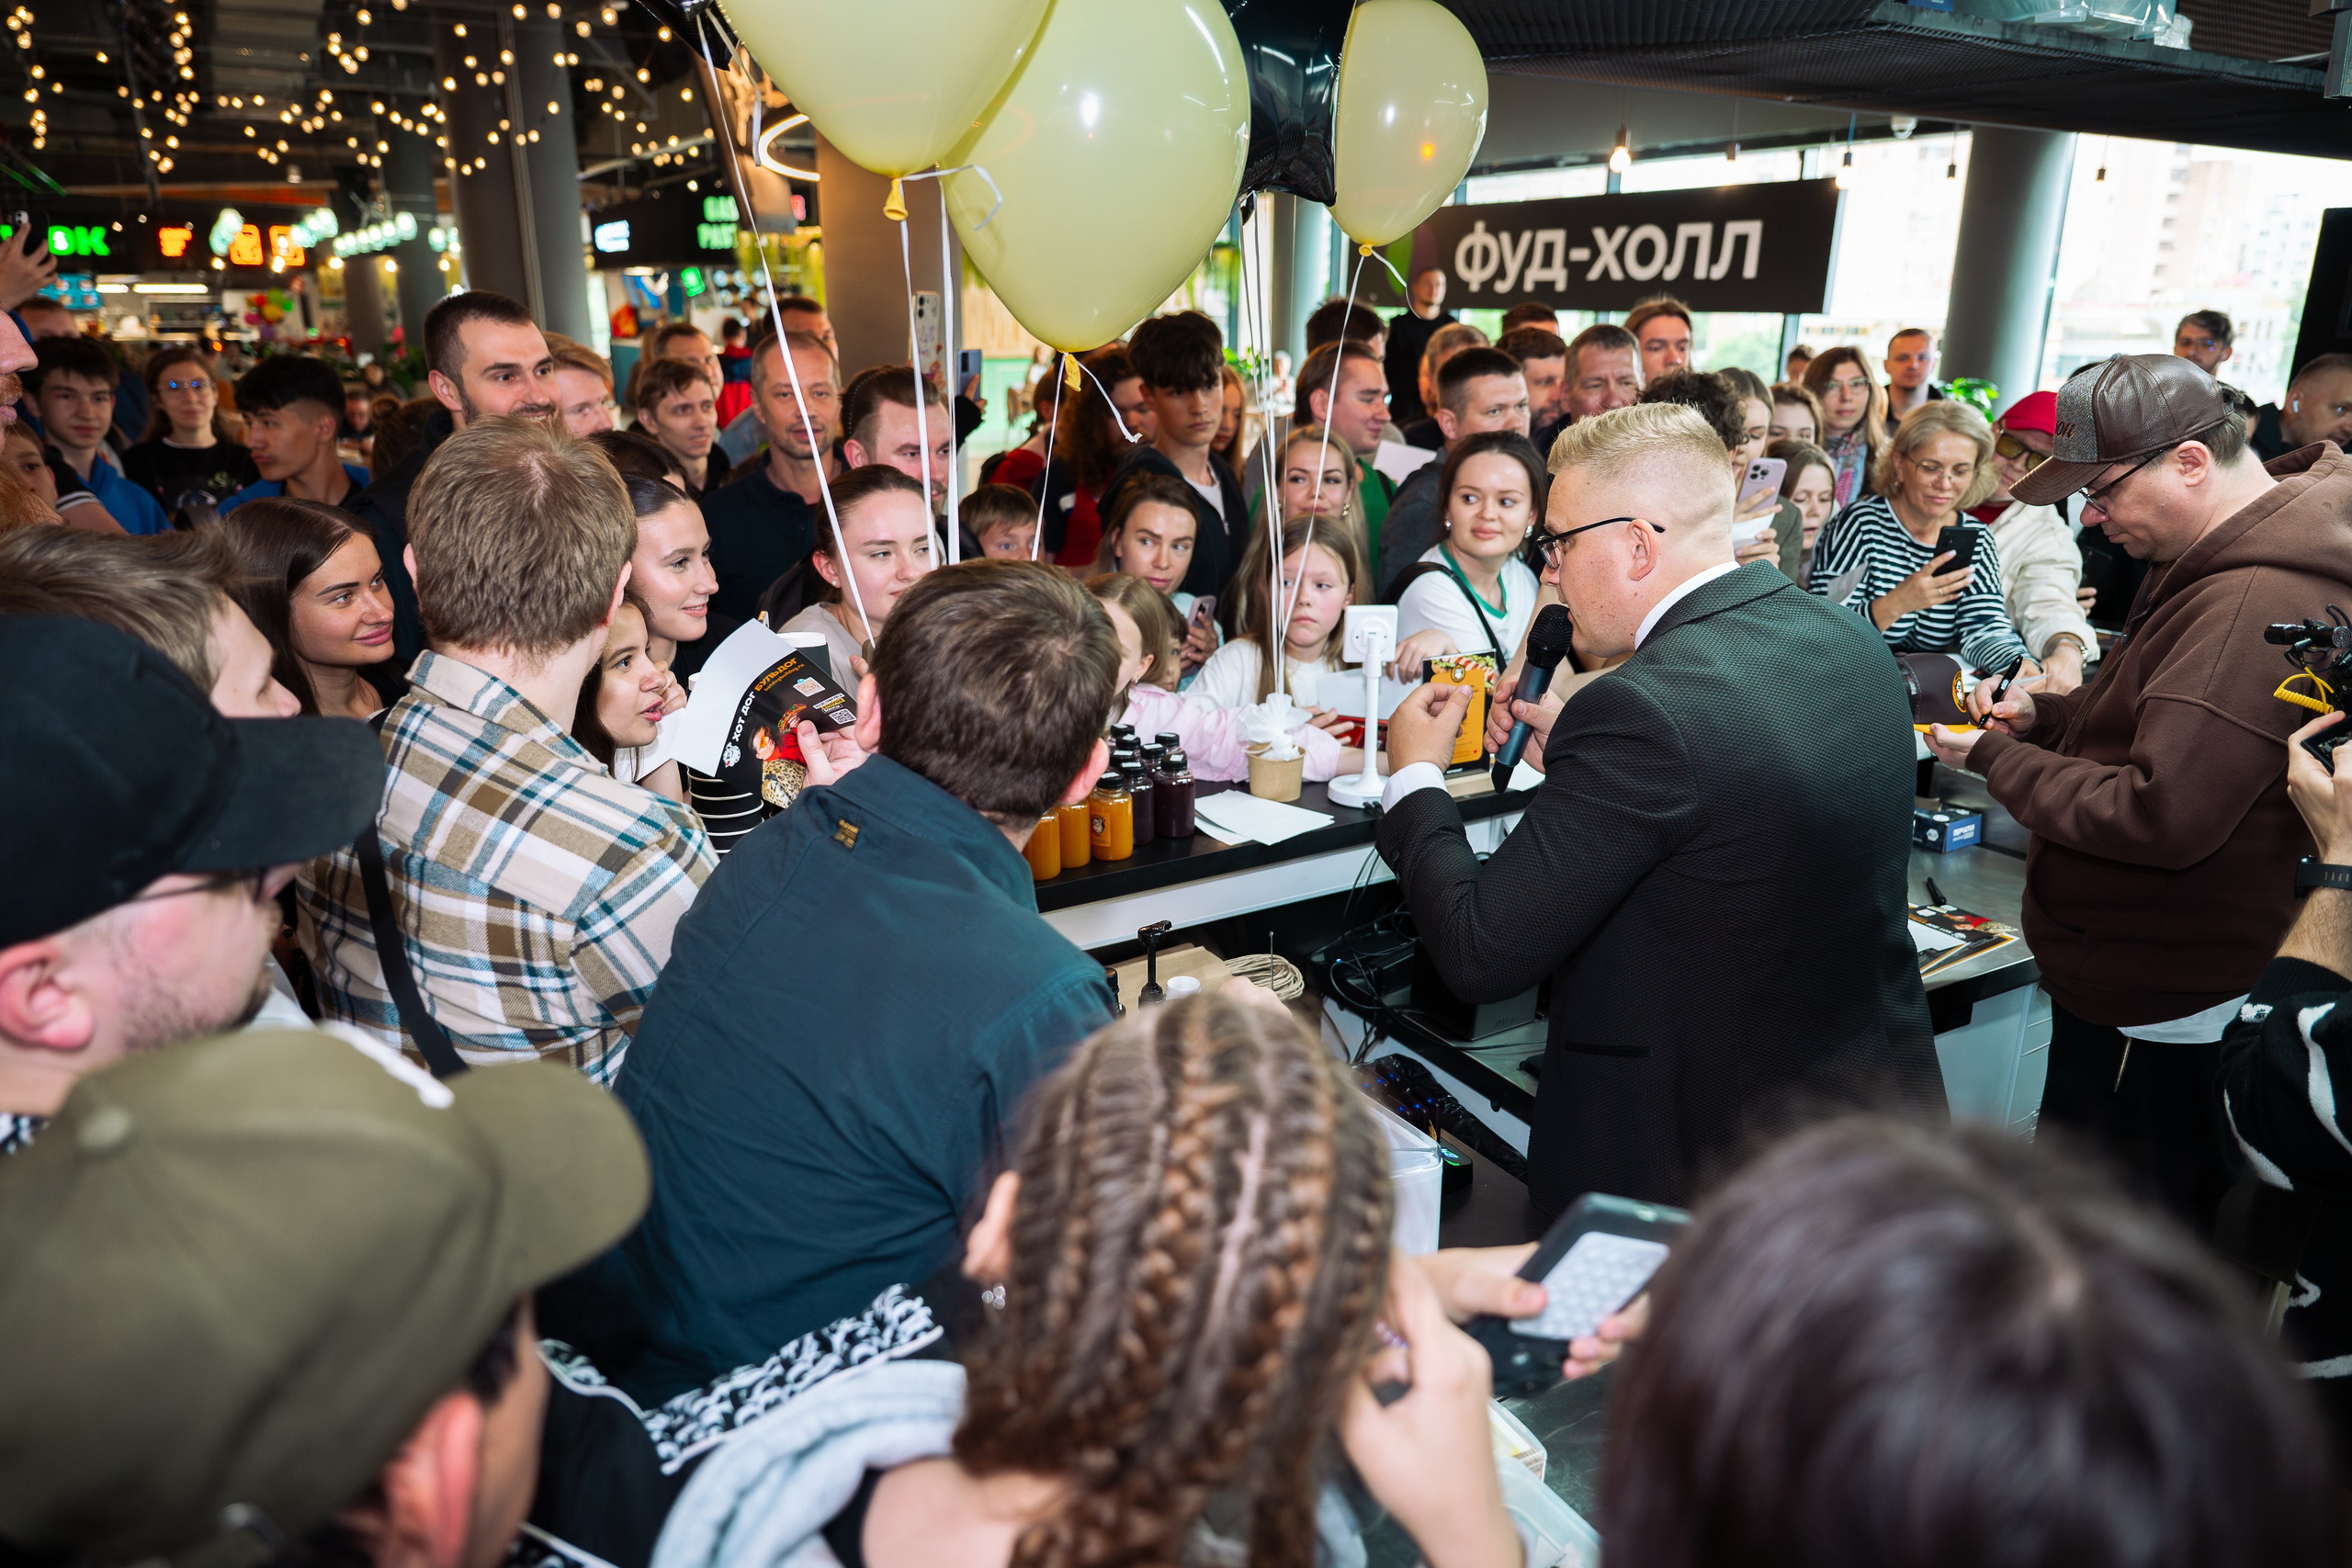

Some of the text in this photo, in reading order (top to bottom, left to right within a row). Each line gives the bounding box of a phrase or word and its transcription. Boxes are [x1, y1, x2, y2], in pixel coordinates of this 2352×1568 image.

[732, 657, 797, 742] ХОТ ДОГ БУЛЬДОГ
